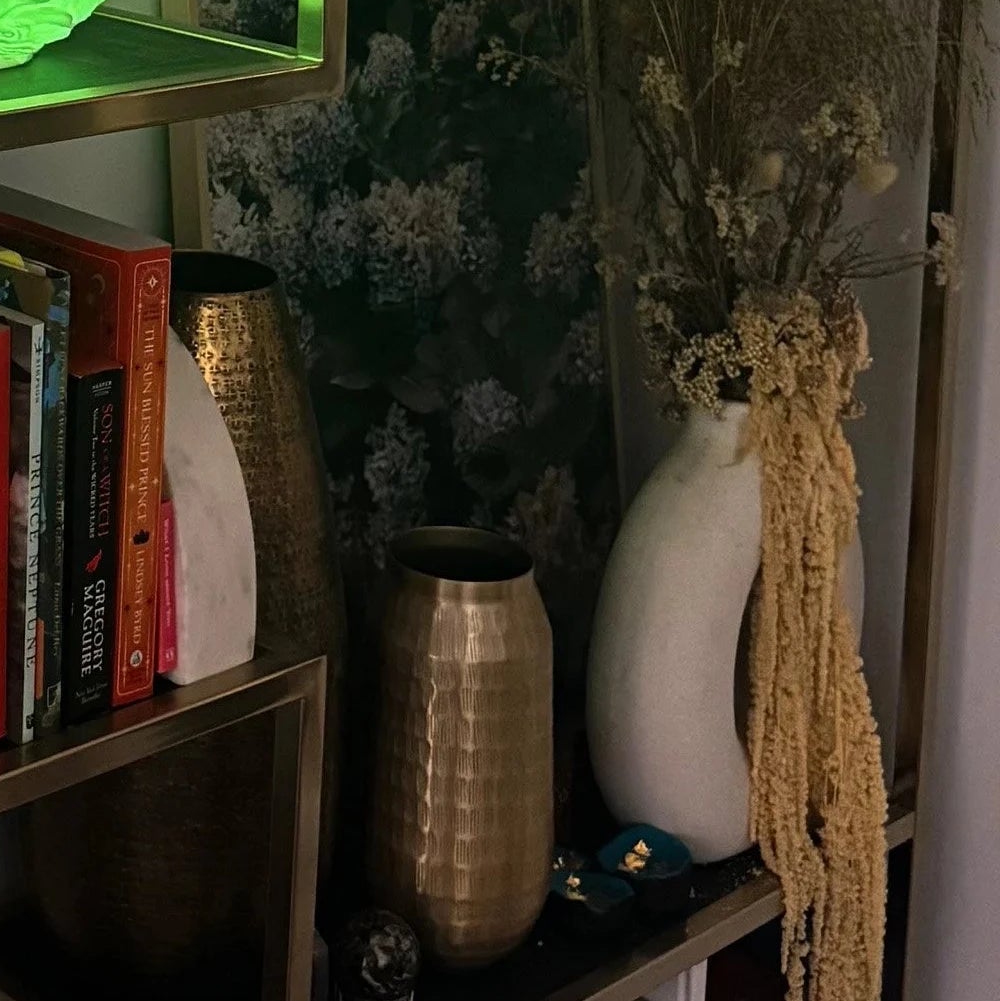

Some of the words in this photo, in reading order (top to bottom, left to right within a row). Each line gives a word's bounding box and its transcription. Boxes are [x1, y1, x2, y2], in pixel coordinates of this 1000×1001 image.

[143, 328, 155, 354] THE
[142, 361, 154, 395] SUN
[100, 403, 114, 445] SON
[140, 399, 152, 463] BLESSED
[29, 452, 43, 544] PRINCE
[97, 473, 112, 537] WITCH
[137, 467, 150, 521] PRINCE
[134, 549, 146, 605] LINDSEY
[26, 552, 38, 669] NEPTUNE
[80, 583, 95, 678] MAGUIRE
[92, 579, 106, 672] GREGORY
[132, 609, 142, 645] BYRD
